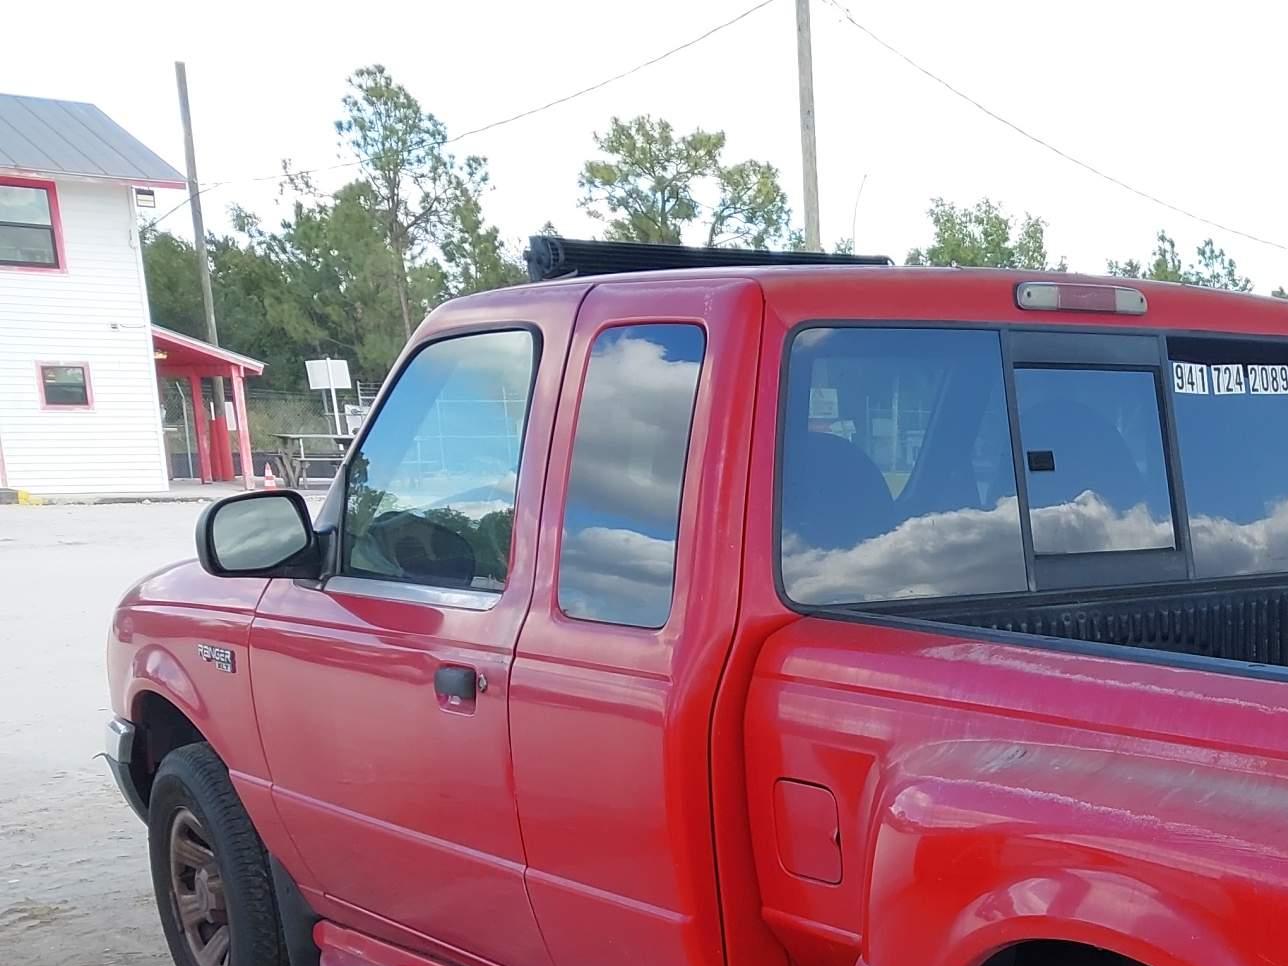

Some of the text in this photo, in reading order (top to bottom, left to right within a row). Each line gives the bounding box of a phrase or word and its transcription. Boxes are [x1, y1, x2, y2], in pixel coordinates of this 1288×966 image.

[1174, 363, 1288, 393] 941 724 2089
[197, 643, 232, 664] RANGER
